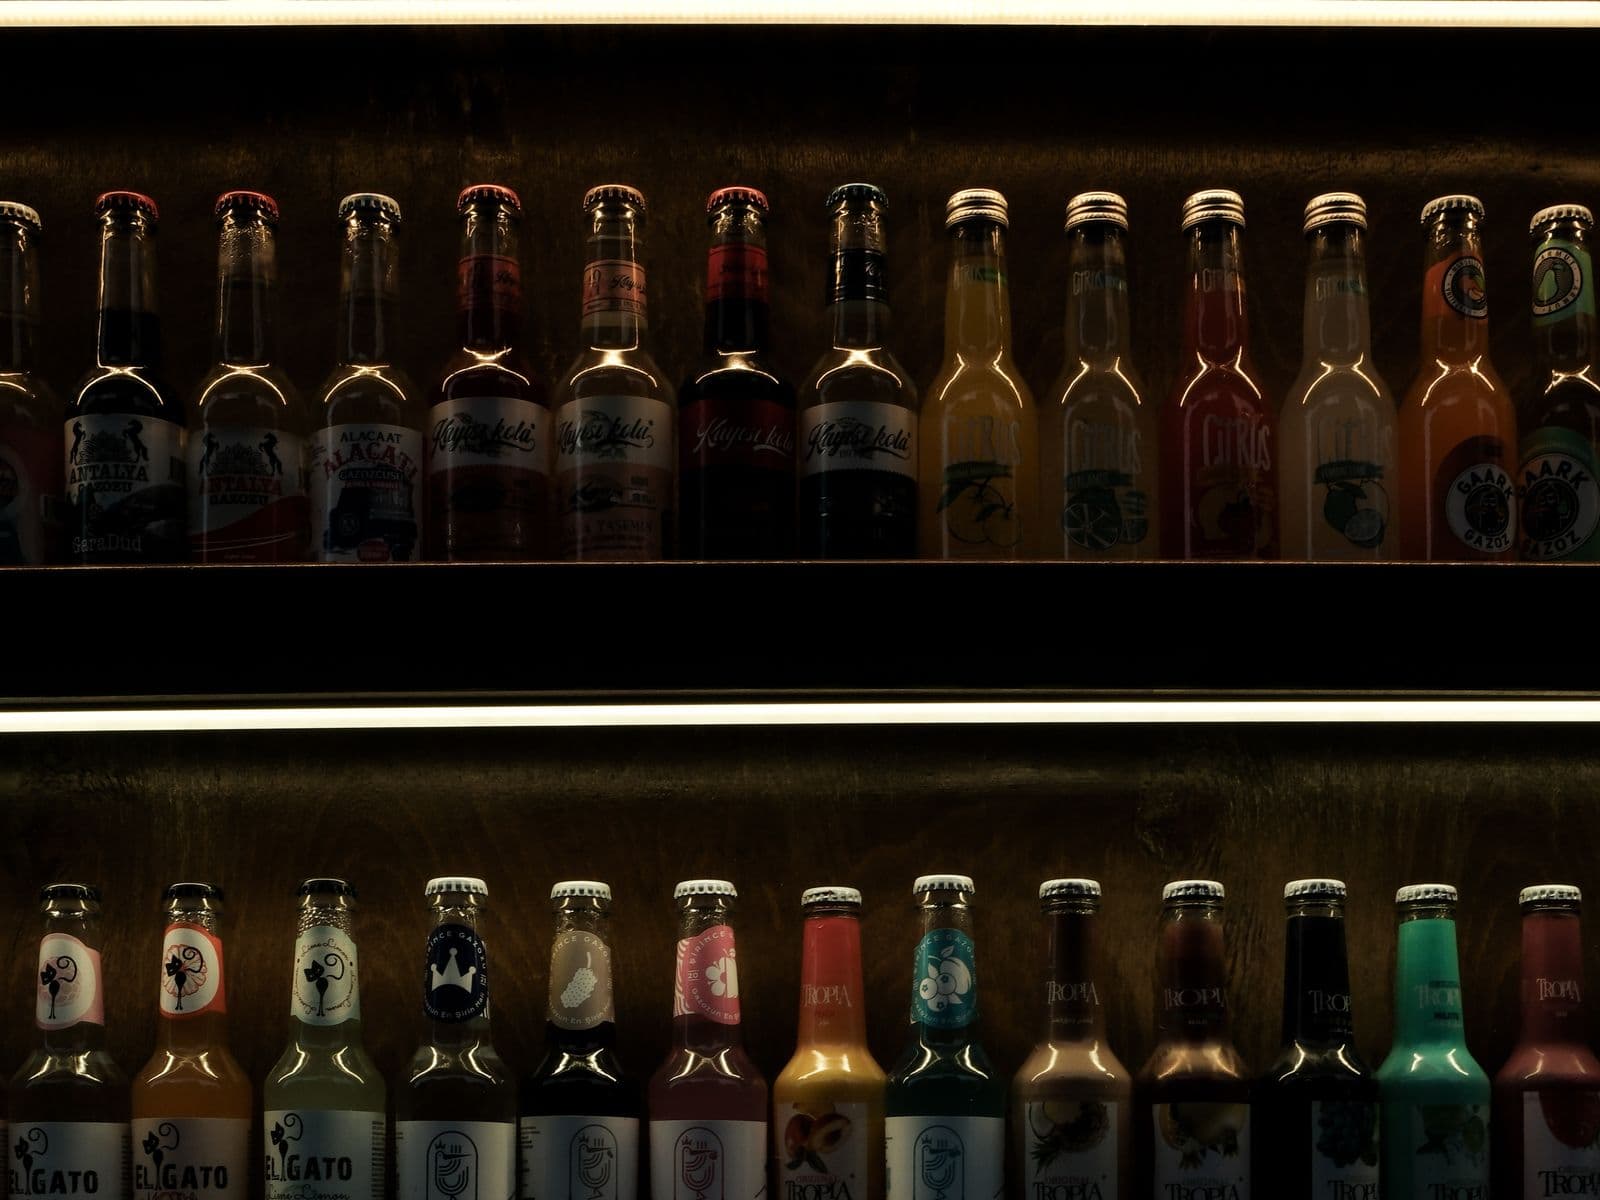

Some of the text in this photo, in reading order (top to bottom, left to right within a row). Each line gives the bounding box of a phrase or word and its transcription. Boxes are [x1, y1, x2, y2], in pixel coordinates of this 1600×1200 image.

[70, 465, 149, 484] ANTALYA
[1457, 467, 1514, 500] GAARK
[1464, 529, 1511, 550] GAZOZ
